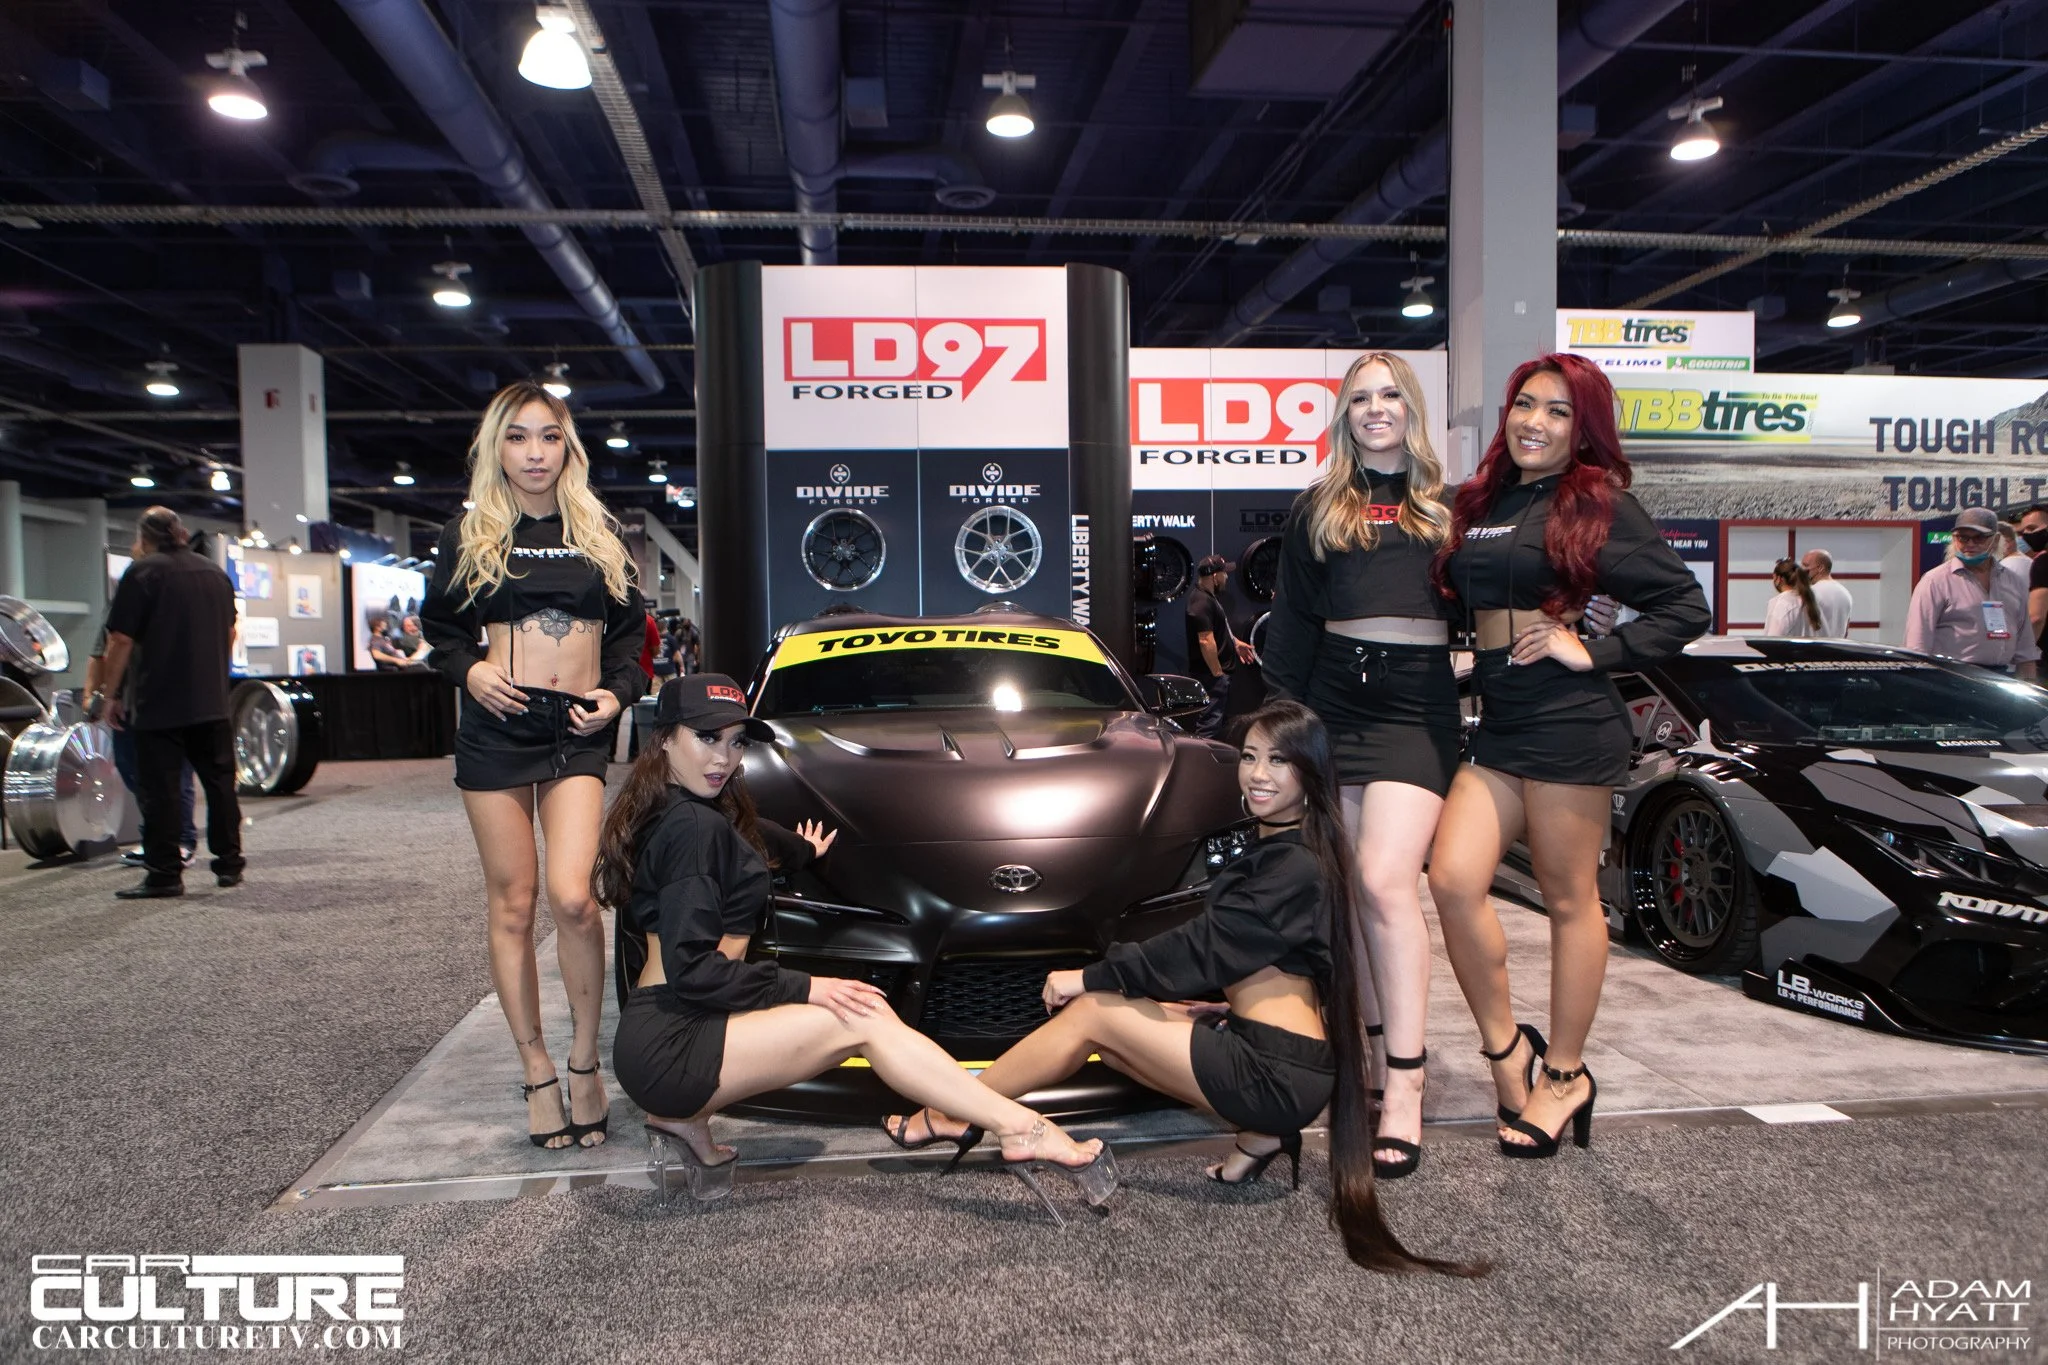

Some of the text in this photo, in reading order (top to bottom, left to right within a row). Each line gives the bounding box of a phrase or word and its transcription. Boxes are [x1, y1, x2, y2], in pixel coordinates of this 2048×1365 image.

[788, 319, 1042, 397] LD97
[793, 385, 953, 400] FORGED
[1138, 382, 1337, 442] LD9
[1870, 416, 1995, 454] TOUGH
[1140, 450, 1308, 465] FORGED
[796, 485, 890, 498] DIVIDE
[949, 484, 1041, 497] DIVIDE
[1883, 476, 2009, 512] TOUGH
[1162, 515, 1196, 528] WALK
[1072, 514, 1090, 595] LIBERTY
[1673, 539, 1692, 549] NEAR
[1694, 539, 1708, 549] YOU
[819, 629, 1060, 653] TOYO TIRES
[1797, 994, 1865, 1021] PERFORMANCE
